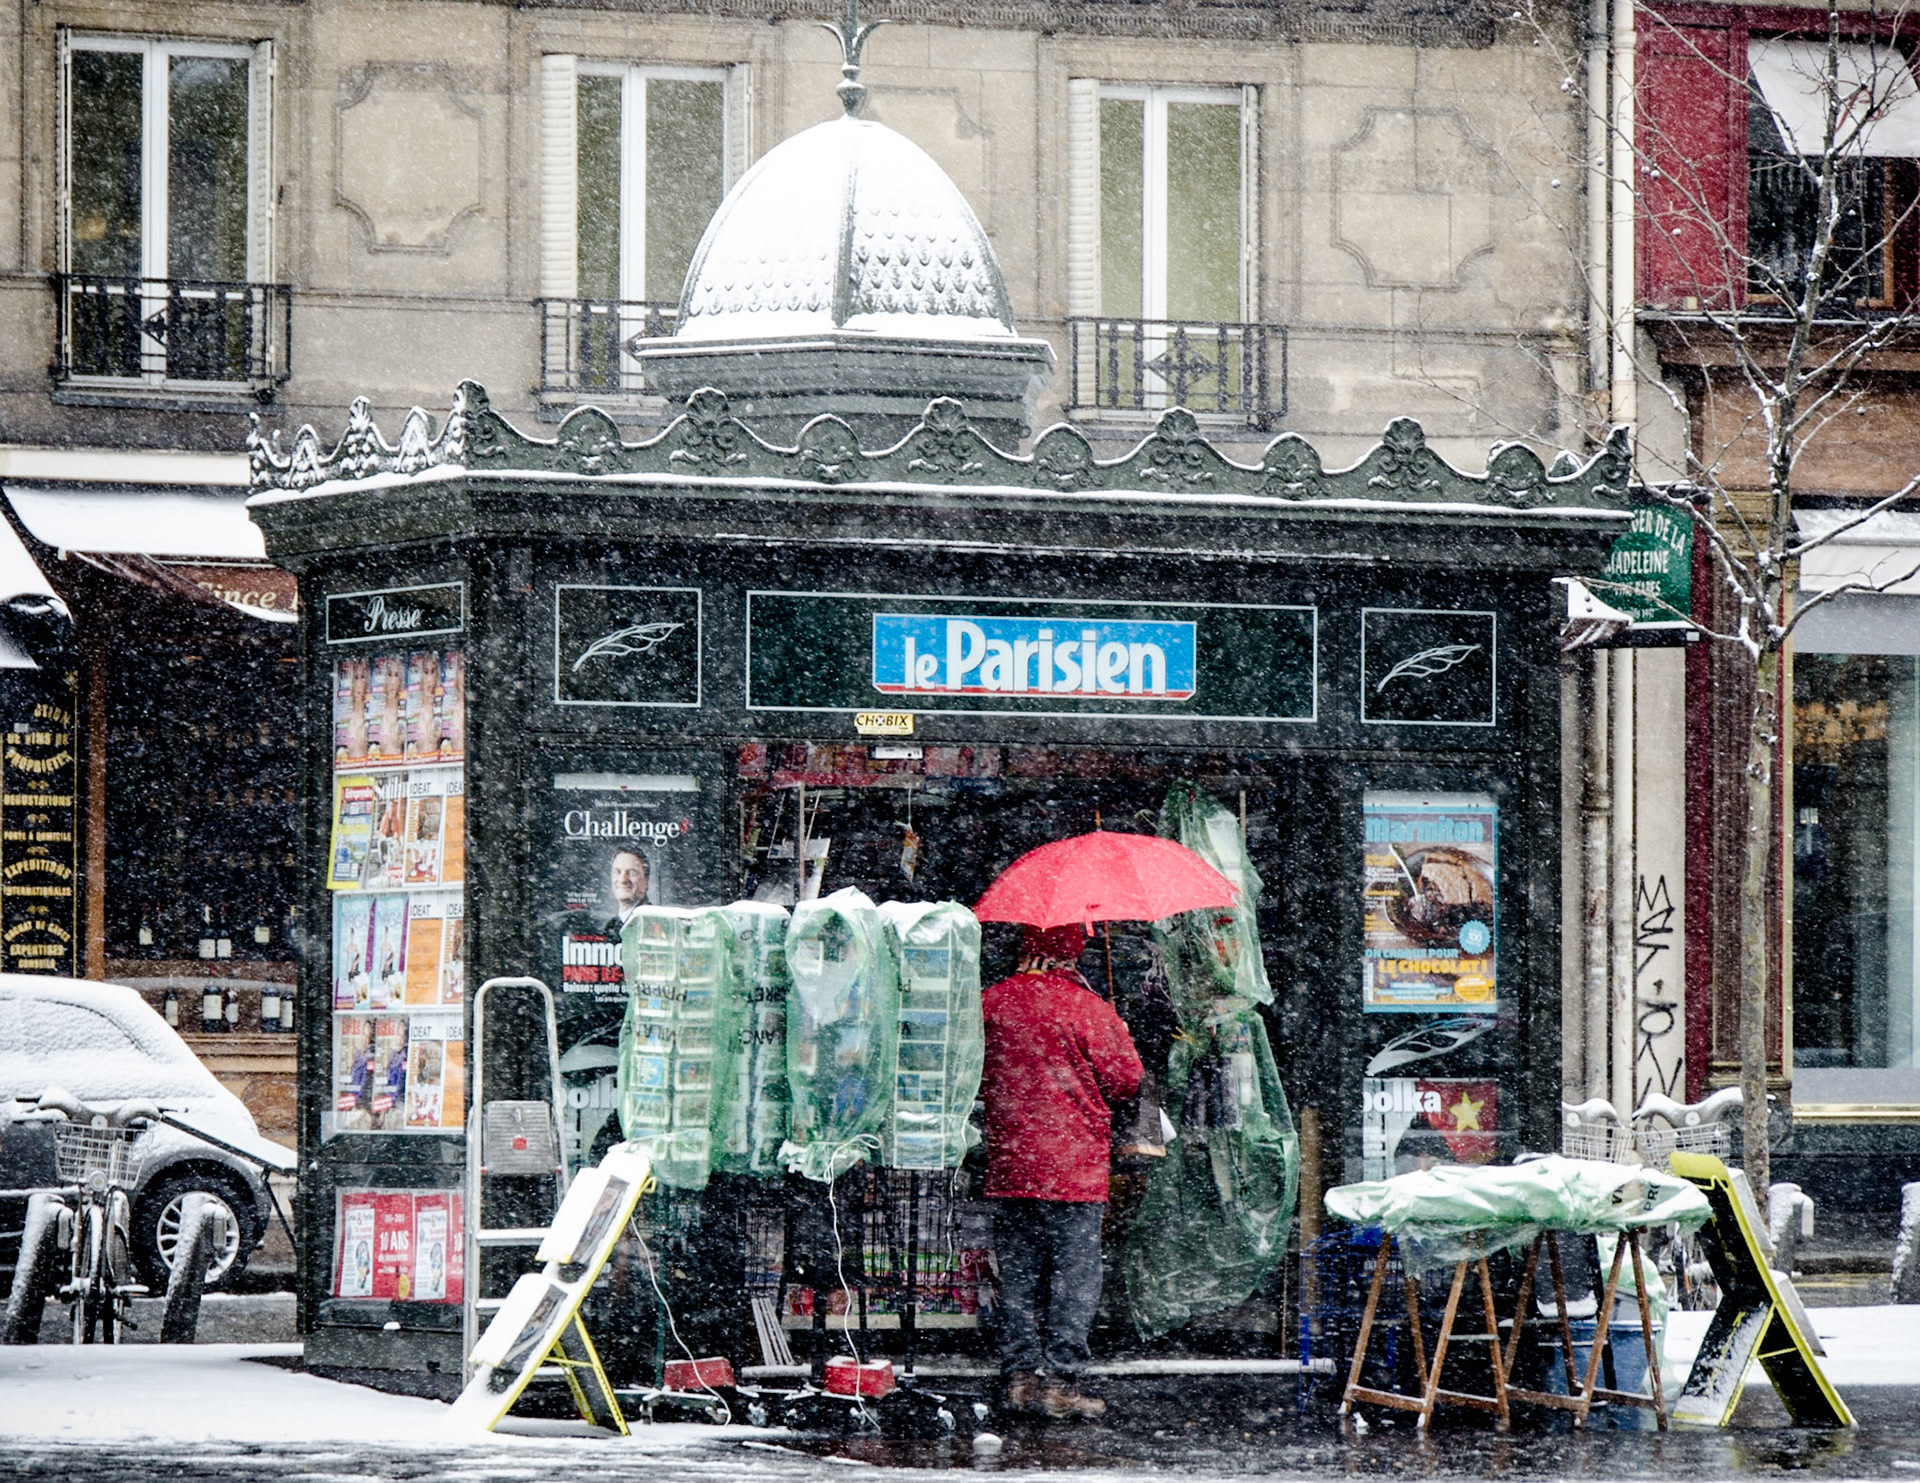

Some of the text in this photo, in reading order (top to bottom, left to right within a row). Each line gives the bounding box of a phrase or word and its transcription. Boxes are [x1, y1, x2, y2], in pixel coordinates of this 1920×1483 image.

[1632, 509, 1653, 533] GER
[364, 595, 421, 632] Presse
[904, 619, 1167, 695] le Parisien
[410, 782, 431, 795] IDEAT
[446, 782, 463, 794] IDEA
[564, 810, 690, 847] Challenges
[410, 904, 431, 917] IDEAT
[446, 903, 463, 916] IDEA
[410, 1026, 431, 1039] IDEAT
[446, 1026, 463, 1038] IDEA
